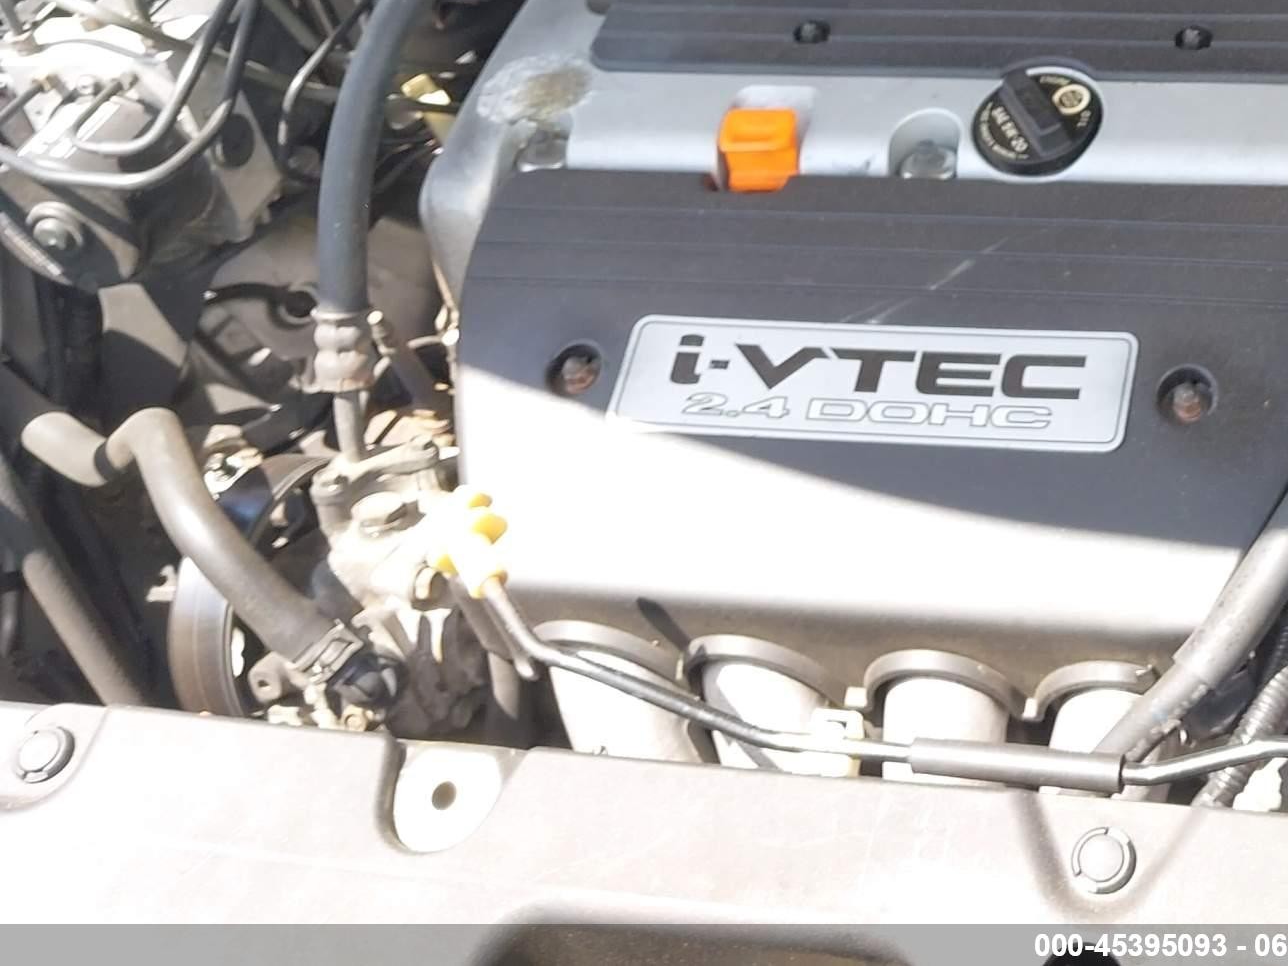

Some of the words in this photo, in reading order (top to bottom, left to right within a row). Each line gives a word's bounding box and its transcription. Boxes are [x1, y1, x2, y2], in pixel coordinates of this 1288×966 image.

[670, 334, 1087, 400] i-VTEC
[682, 391, 790, 421] 2.4
[804, 397, 1053, 429] DOHC
